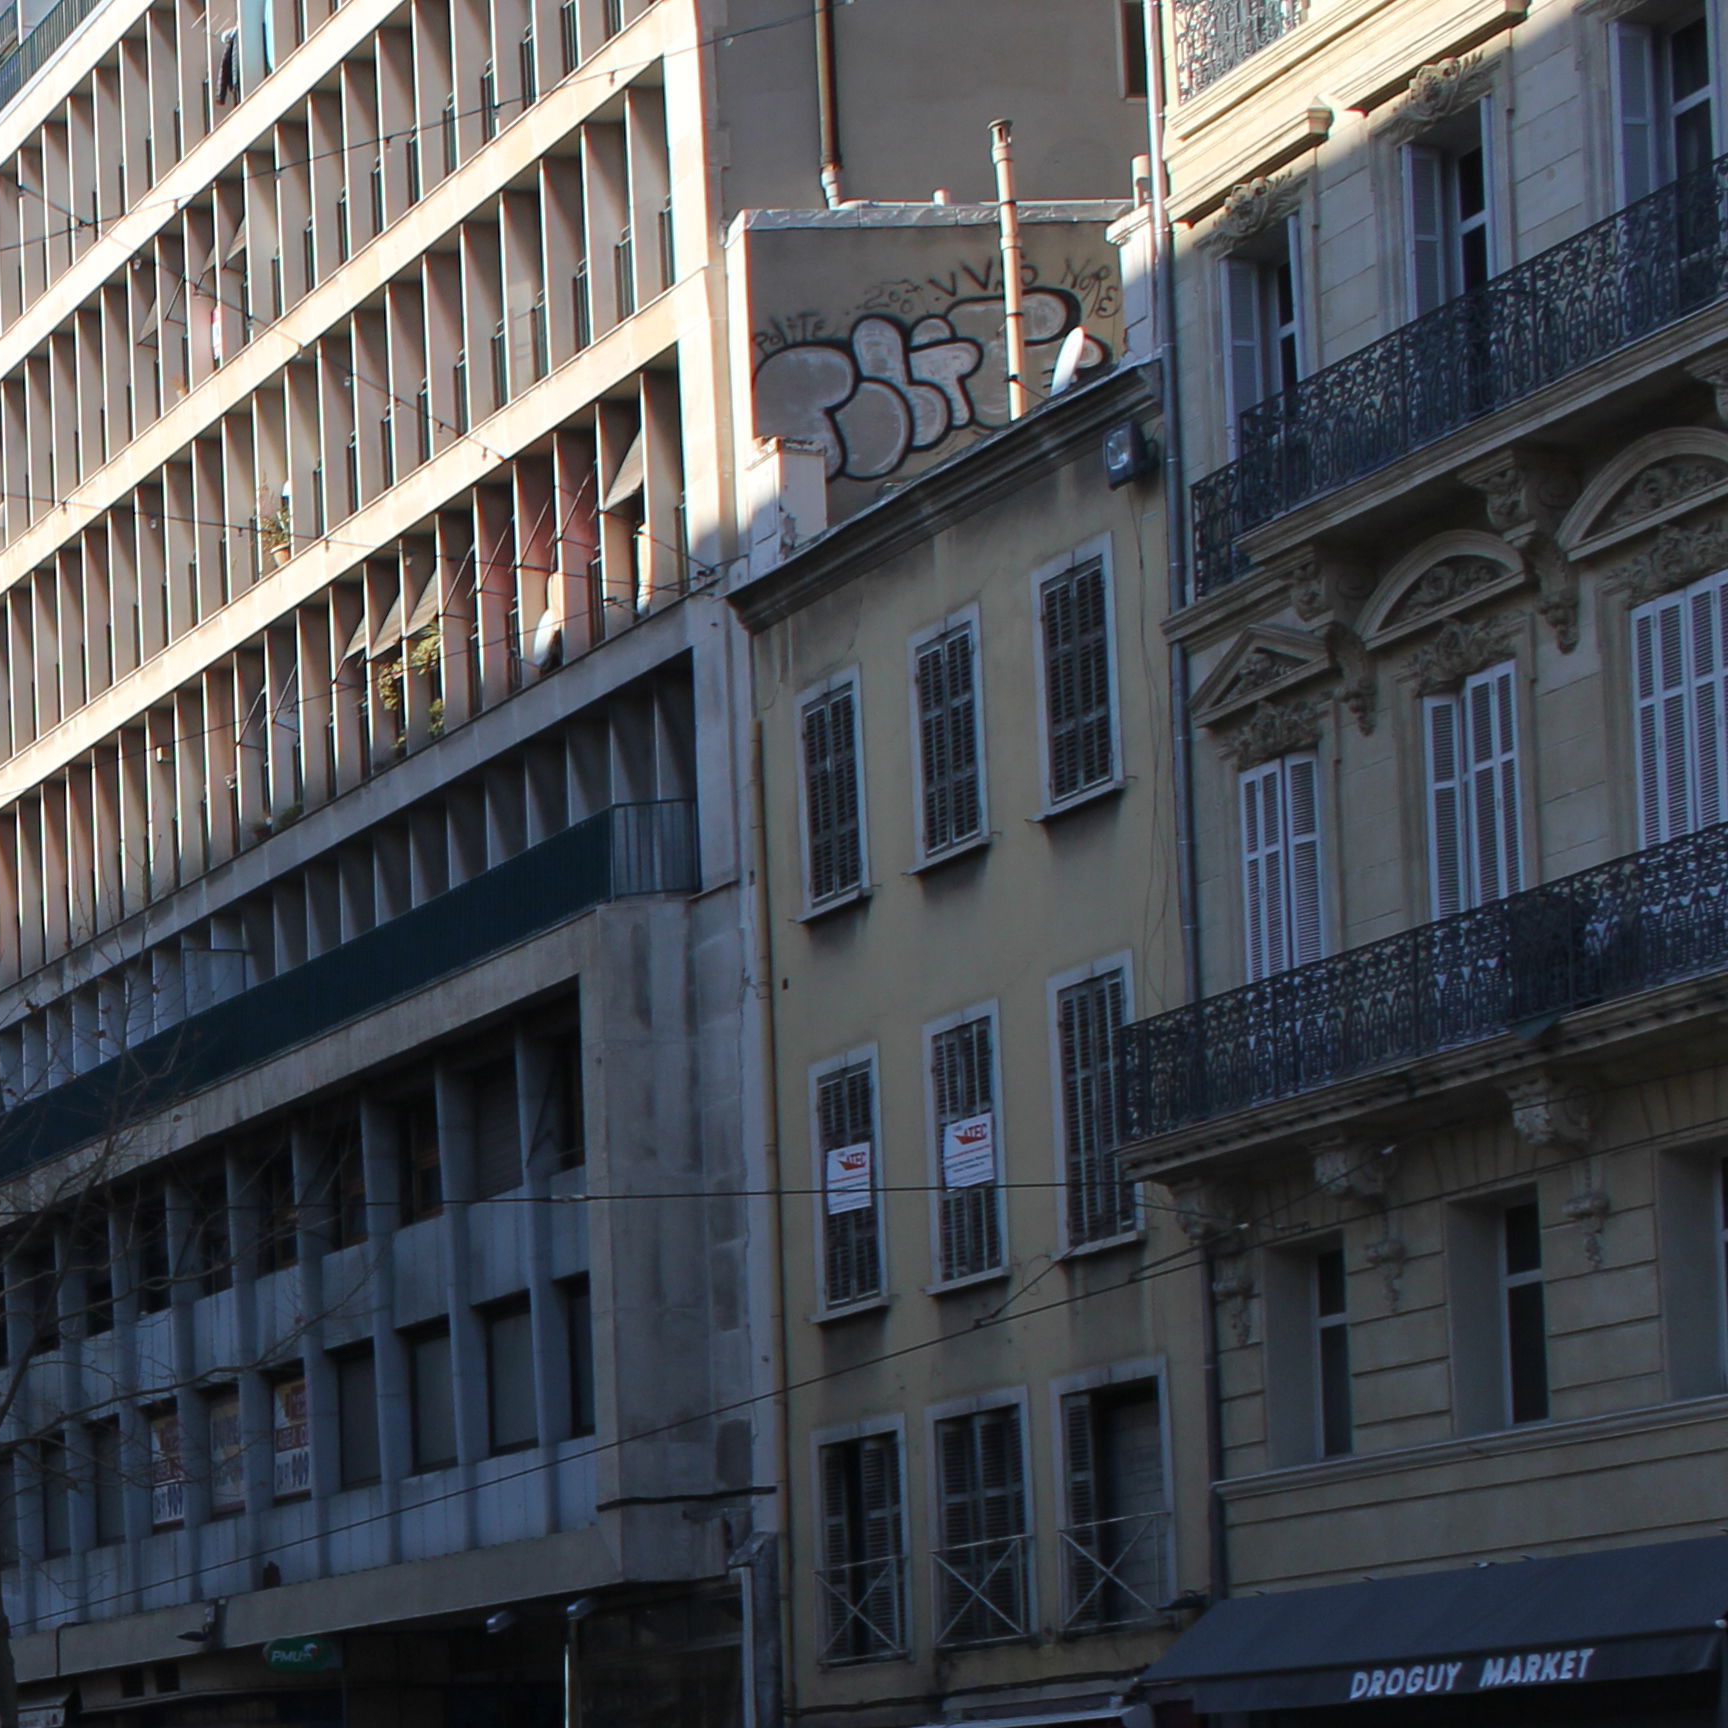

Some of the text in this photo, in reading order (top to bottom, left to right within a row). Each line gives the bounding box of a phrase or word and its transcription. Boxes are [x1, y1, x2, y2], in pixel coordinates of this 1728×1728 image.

[271, 1650, 302, 1663] PMU
[1348, 1647, 1598, 1700] DROGUY MARKET
